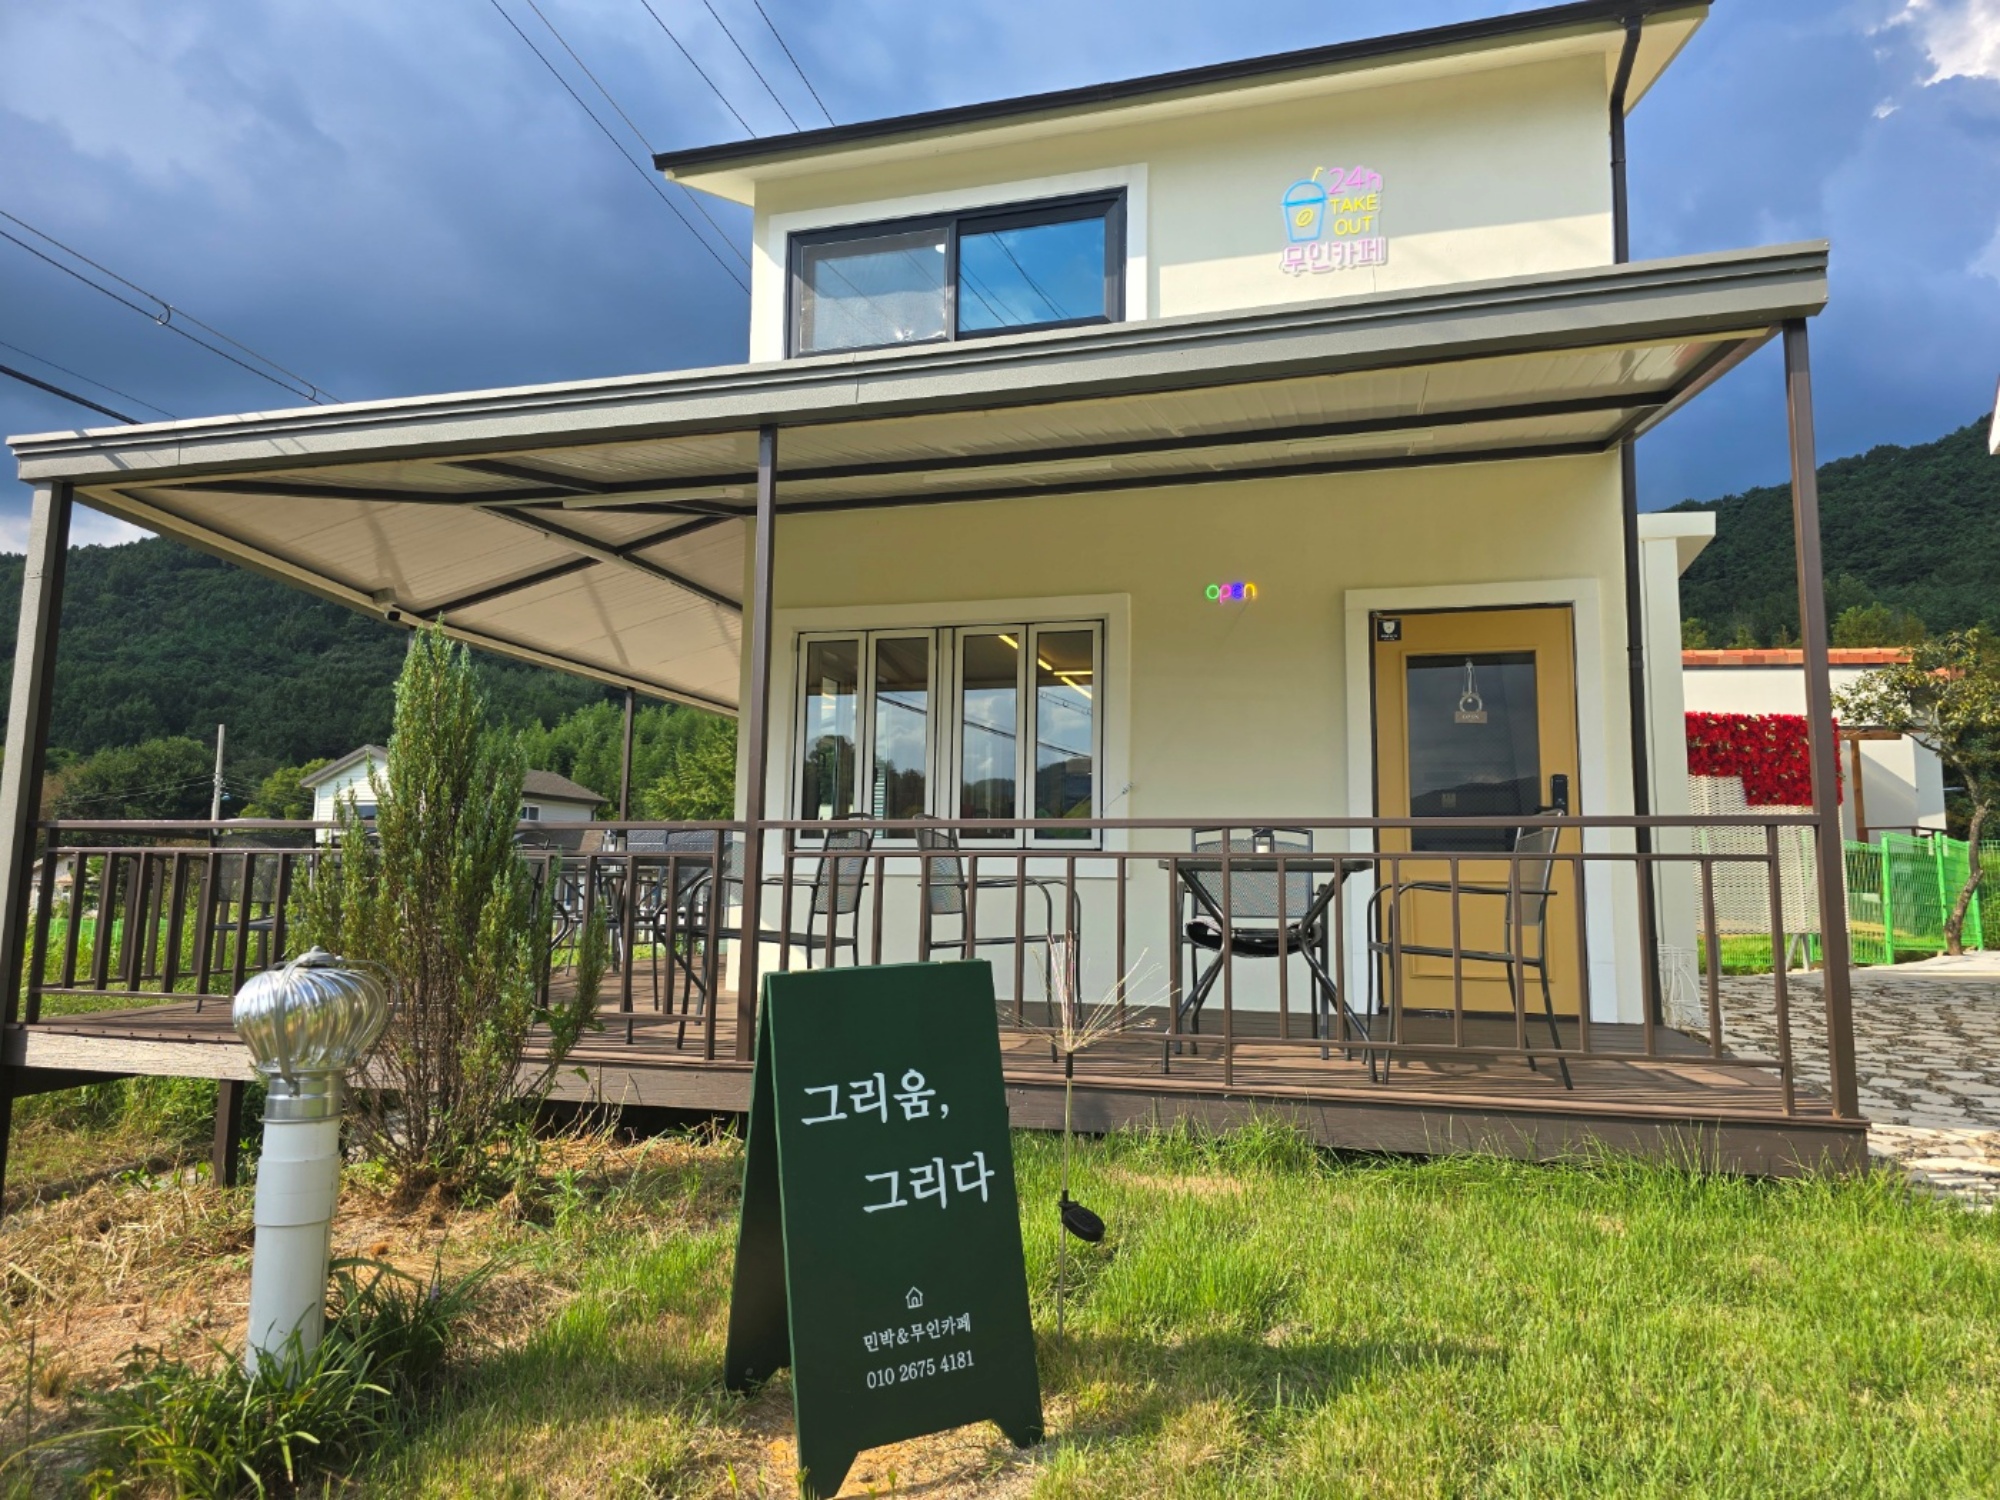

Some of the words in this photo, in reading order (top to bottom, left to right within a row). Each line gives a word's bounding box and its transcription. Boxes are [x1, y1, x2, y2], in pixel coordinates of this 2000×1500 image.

[1329, 194, 1378, 214] TAKE
[1334, 215, 1373, 235] OUT
[1283, 238, 1387, 273] 무인카페
[801, 1068, 949, 1125] 그리움,
[863, 1151, 995, 1213] 그리다
[863, 1312, 971, 1352] 민박&무인카페
[866, 1367, 895, 1389] 010
[899, 1358, 936, 1382] 2675
[940, 1349, 975, 1372] 4181
